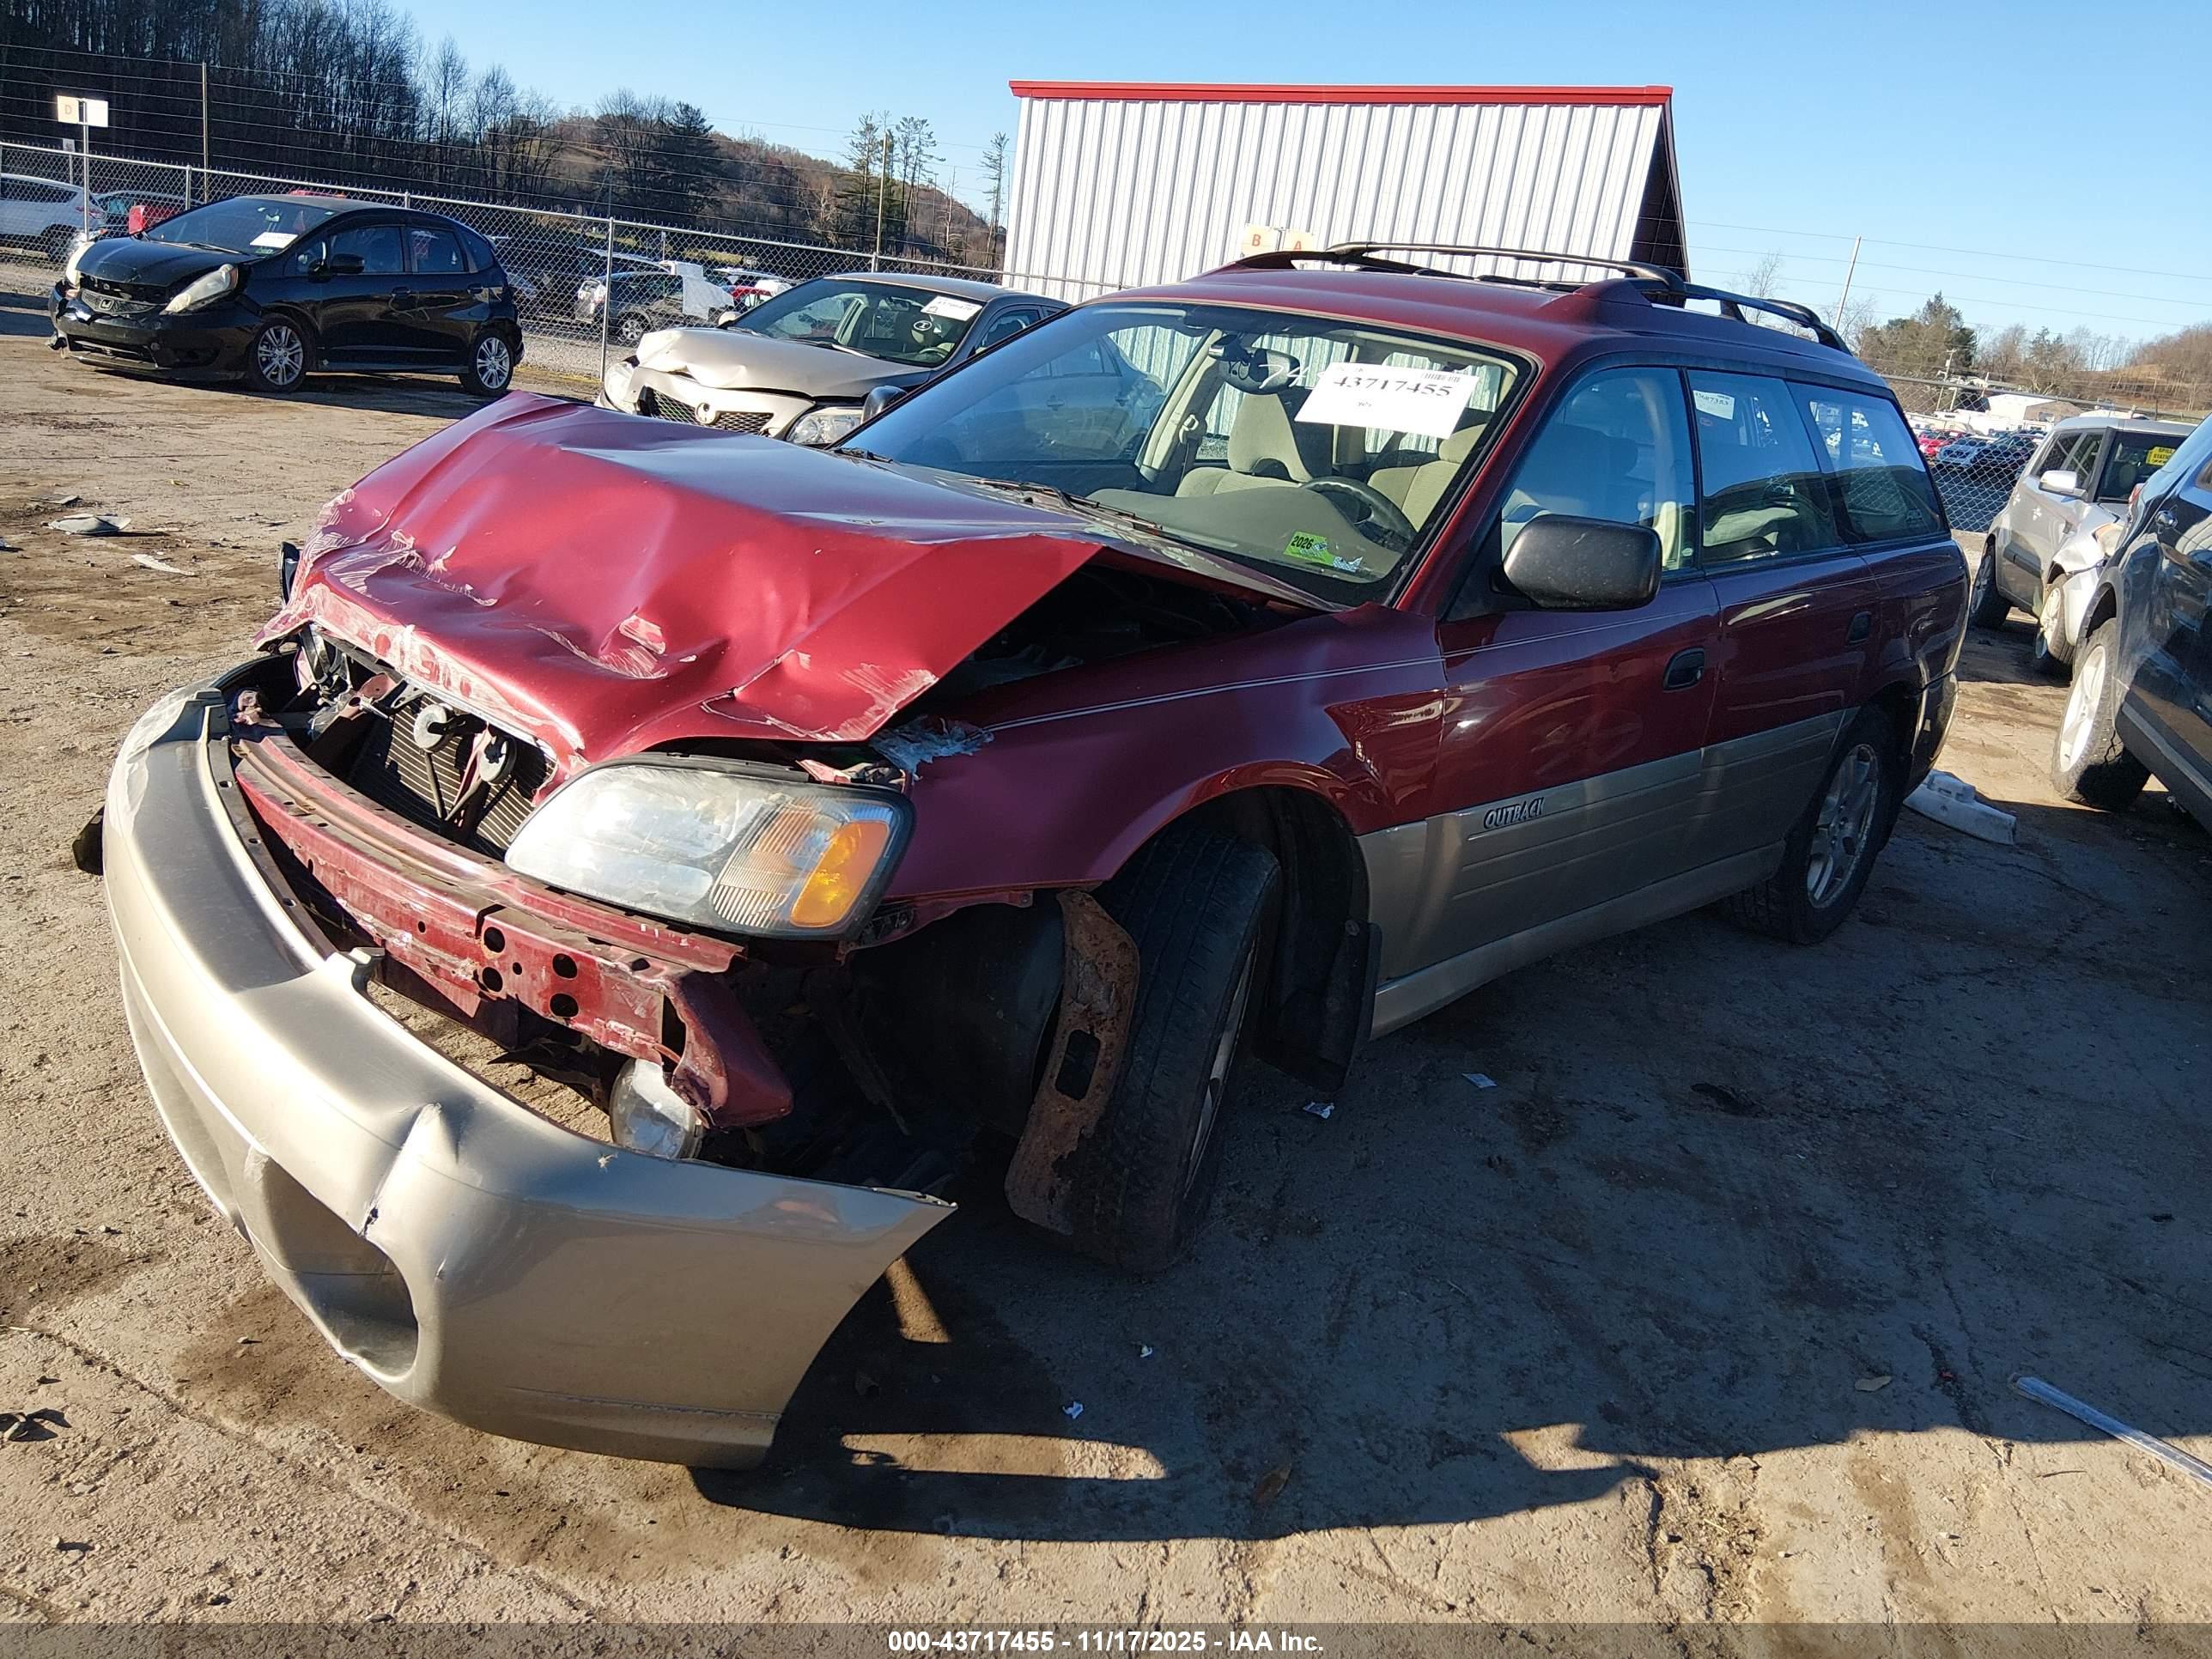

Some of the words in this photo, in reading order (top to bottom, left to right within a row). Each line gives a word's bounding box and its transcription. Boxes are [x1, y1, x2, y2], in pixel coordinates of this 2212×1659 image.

[65, 105, 72, 114] D
[1252, 234, 1261, 246] B
[1293, 240, 1303, 251] A
[1334, 376, 1453, 396] 43717455
[1291, 536, 1314, 550] 2026
[1484, 797, 1544, 829] OUTBACK
